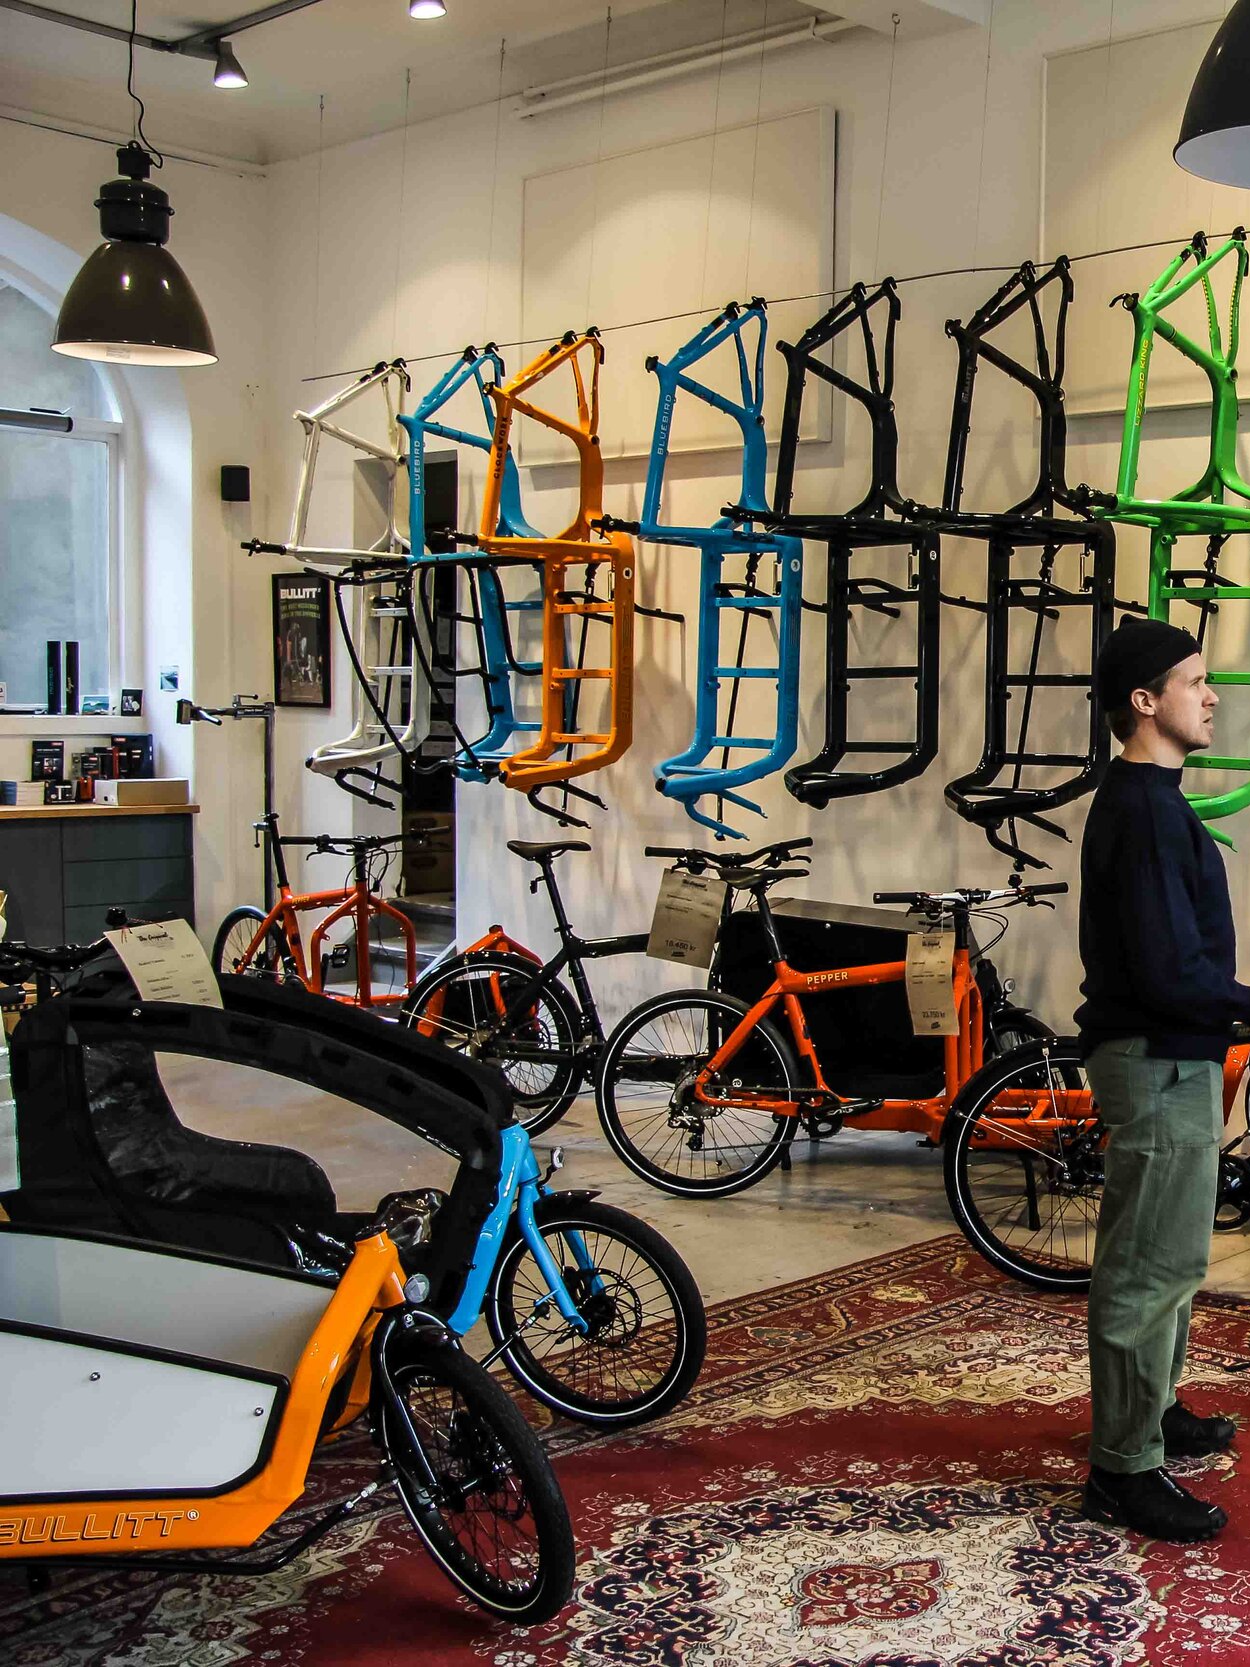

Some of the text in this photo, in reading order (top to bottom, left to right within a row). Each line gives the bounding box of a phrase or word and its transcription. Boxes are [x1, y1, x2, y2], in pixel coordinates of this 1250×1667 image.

[1140, 339, 1150, 370] KING
[657, 394, 672, 455] BLUEBIRD
[807, 971, 848, 985] PEPPER
